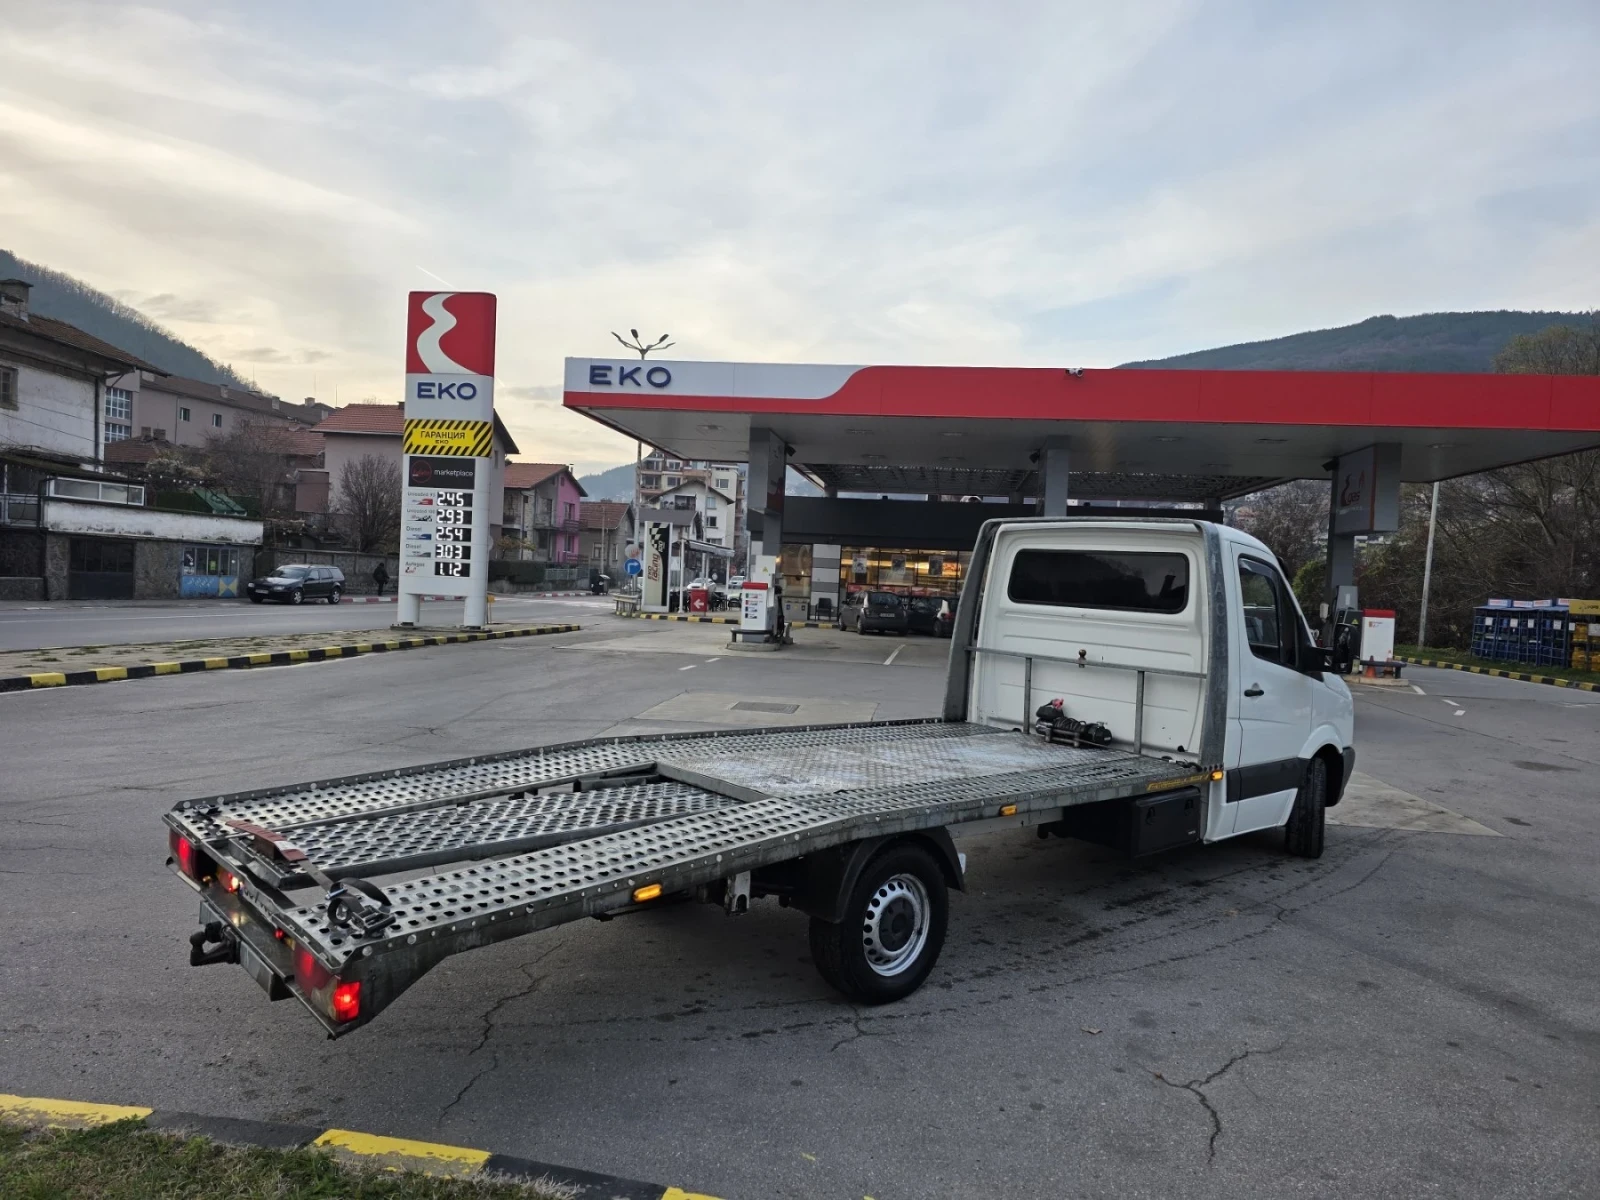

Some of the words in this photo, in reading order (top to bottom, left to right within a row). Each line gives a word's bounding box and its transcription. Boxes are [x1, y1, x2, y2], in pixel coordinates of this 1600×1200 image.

[589, 364, 672, 388] EKO
[417, 381, 477, 400] EKO
[420, 430, 466, 440] ГАРАНЦИЯ
[434, 469, 474, 477] marketplace
[437, 491, 464, 507] 2.45
